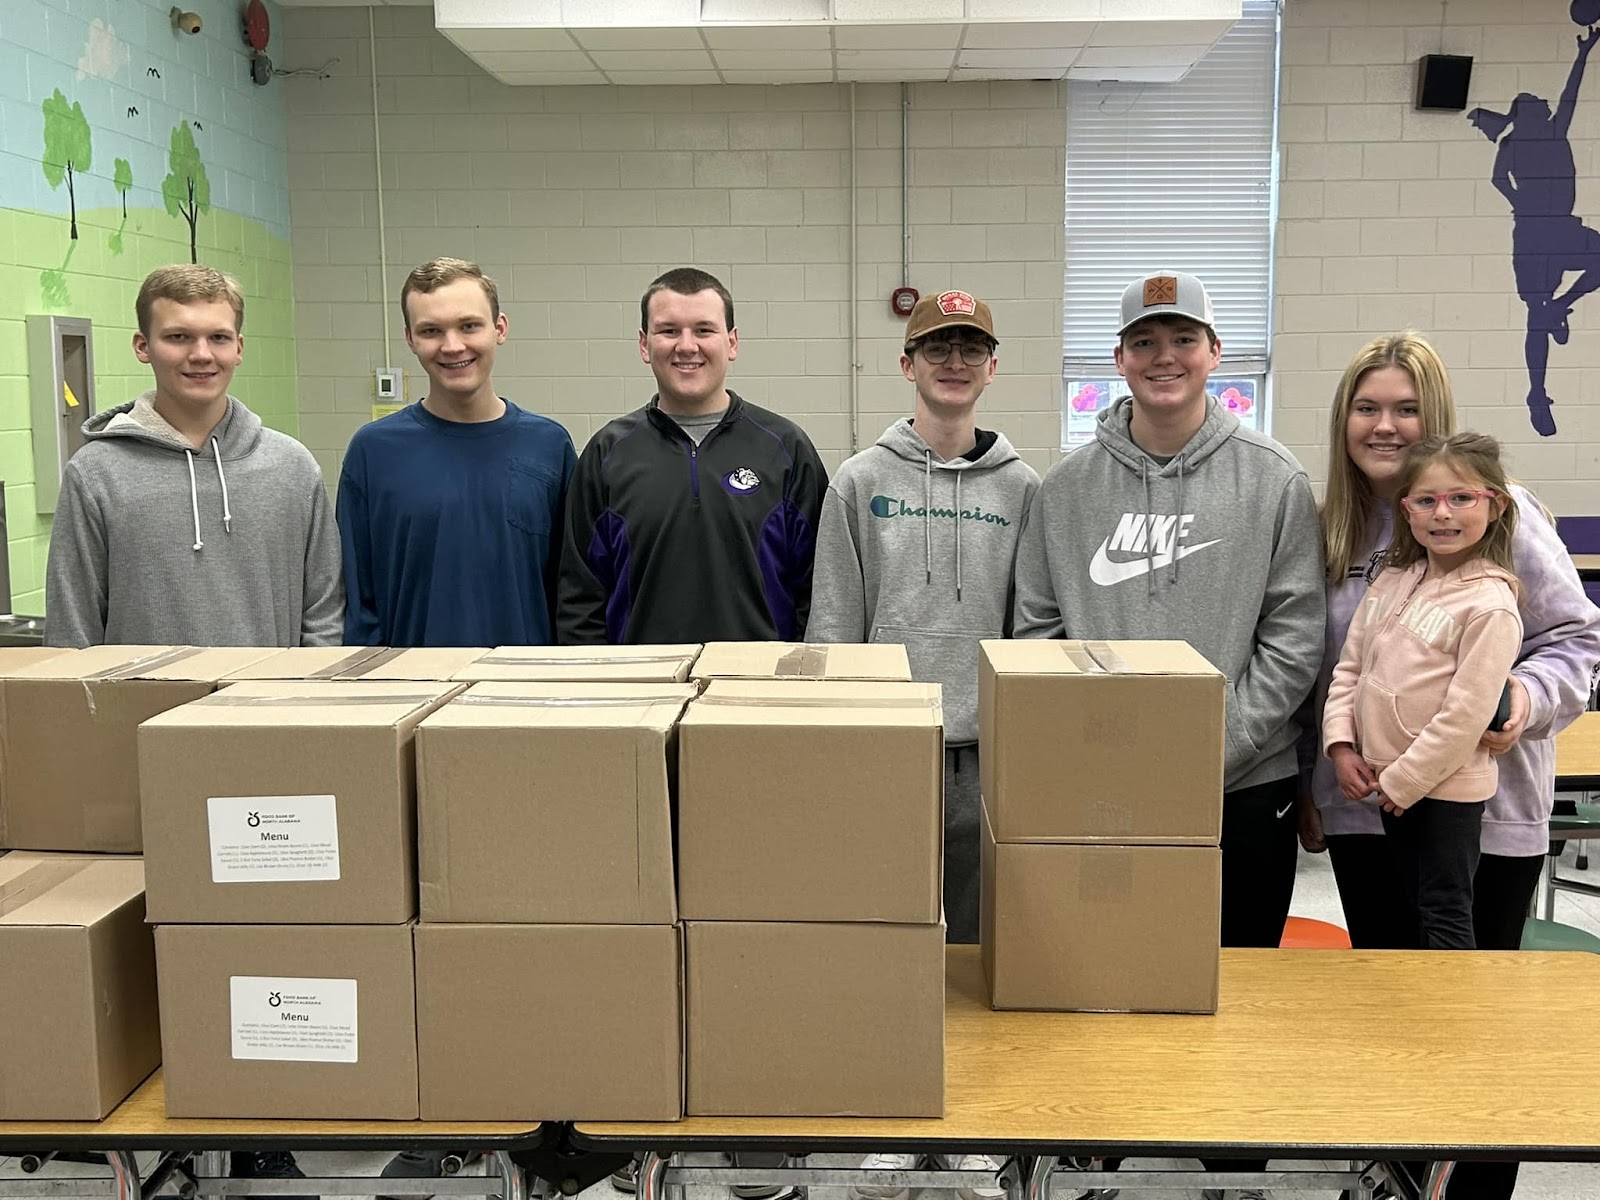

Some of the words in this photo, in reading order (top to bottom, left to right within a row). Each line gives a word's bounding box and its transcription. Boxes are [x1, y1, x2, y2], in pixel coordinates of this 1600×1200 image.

[870, 495, 1011, 527] Champion
[1108, 512, 1195, 553] NIKE
[1399, 595, 1463, 654] NAVY
[260, 832, 289, 841] Menu
[281, 1012, 309, 1021] Menu
